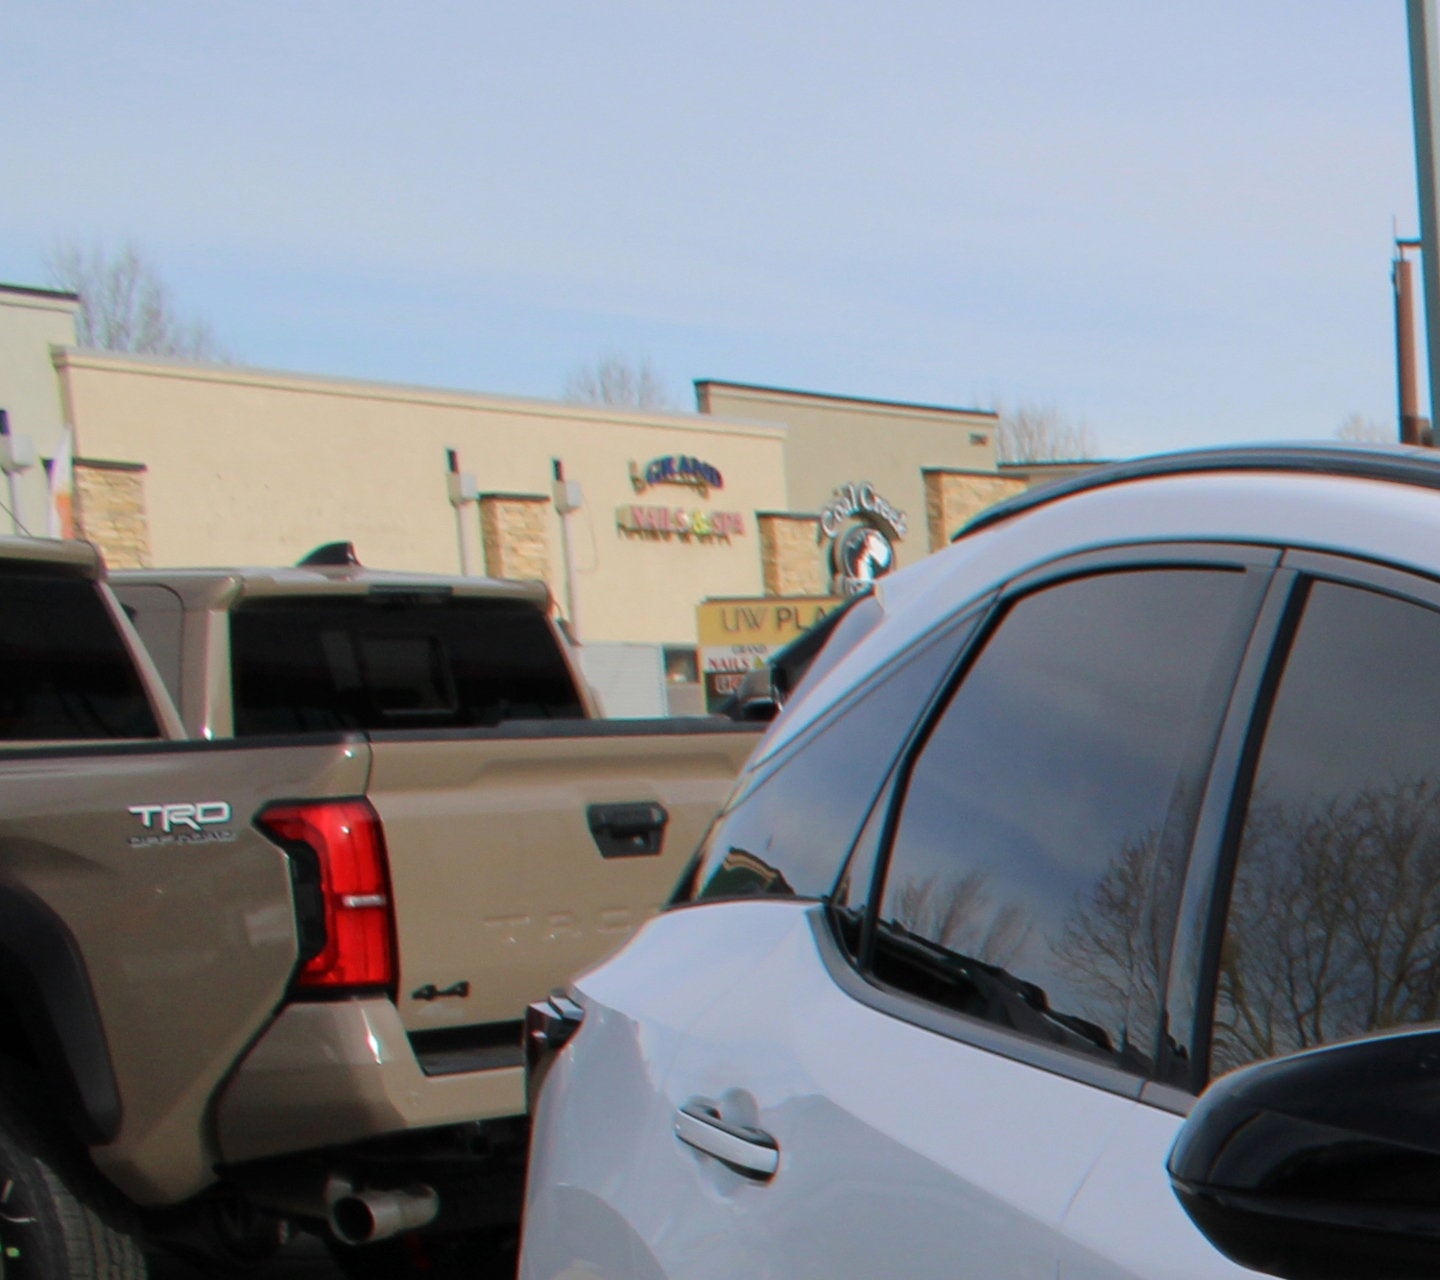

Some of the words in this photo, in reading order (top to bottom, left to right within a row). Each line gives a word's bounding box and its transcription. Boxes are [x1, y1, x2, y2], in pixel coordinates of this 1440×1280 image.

[645, 454, 723, 488] GRAND
[628, 506, 690, 532] NAILS
[712, 511, 745, 536] SPA
[821, 483, 860, 537] Coal
[860, 482, 907, 536] Creek
[722, 606, 767, 632] UW
[776, 606, 830, 632] PLA
[708, 656, 750, 670] NAILS
[128, 801, 231, 833] TRD
[478, 905, 638, 945] TAC
